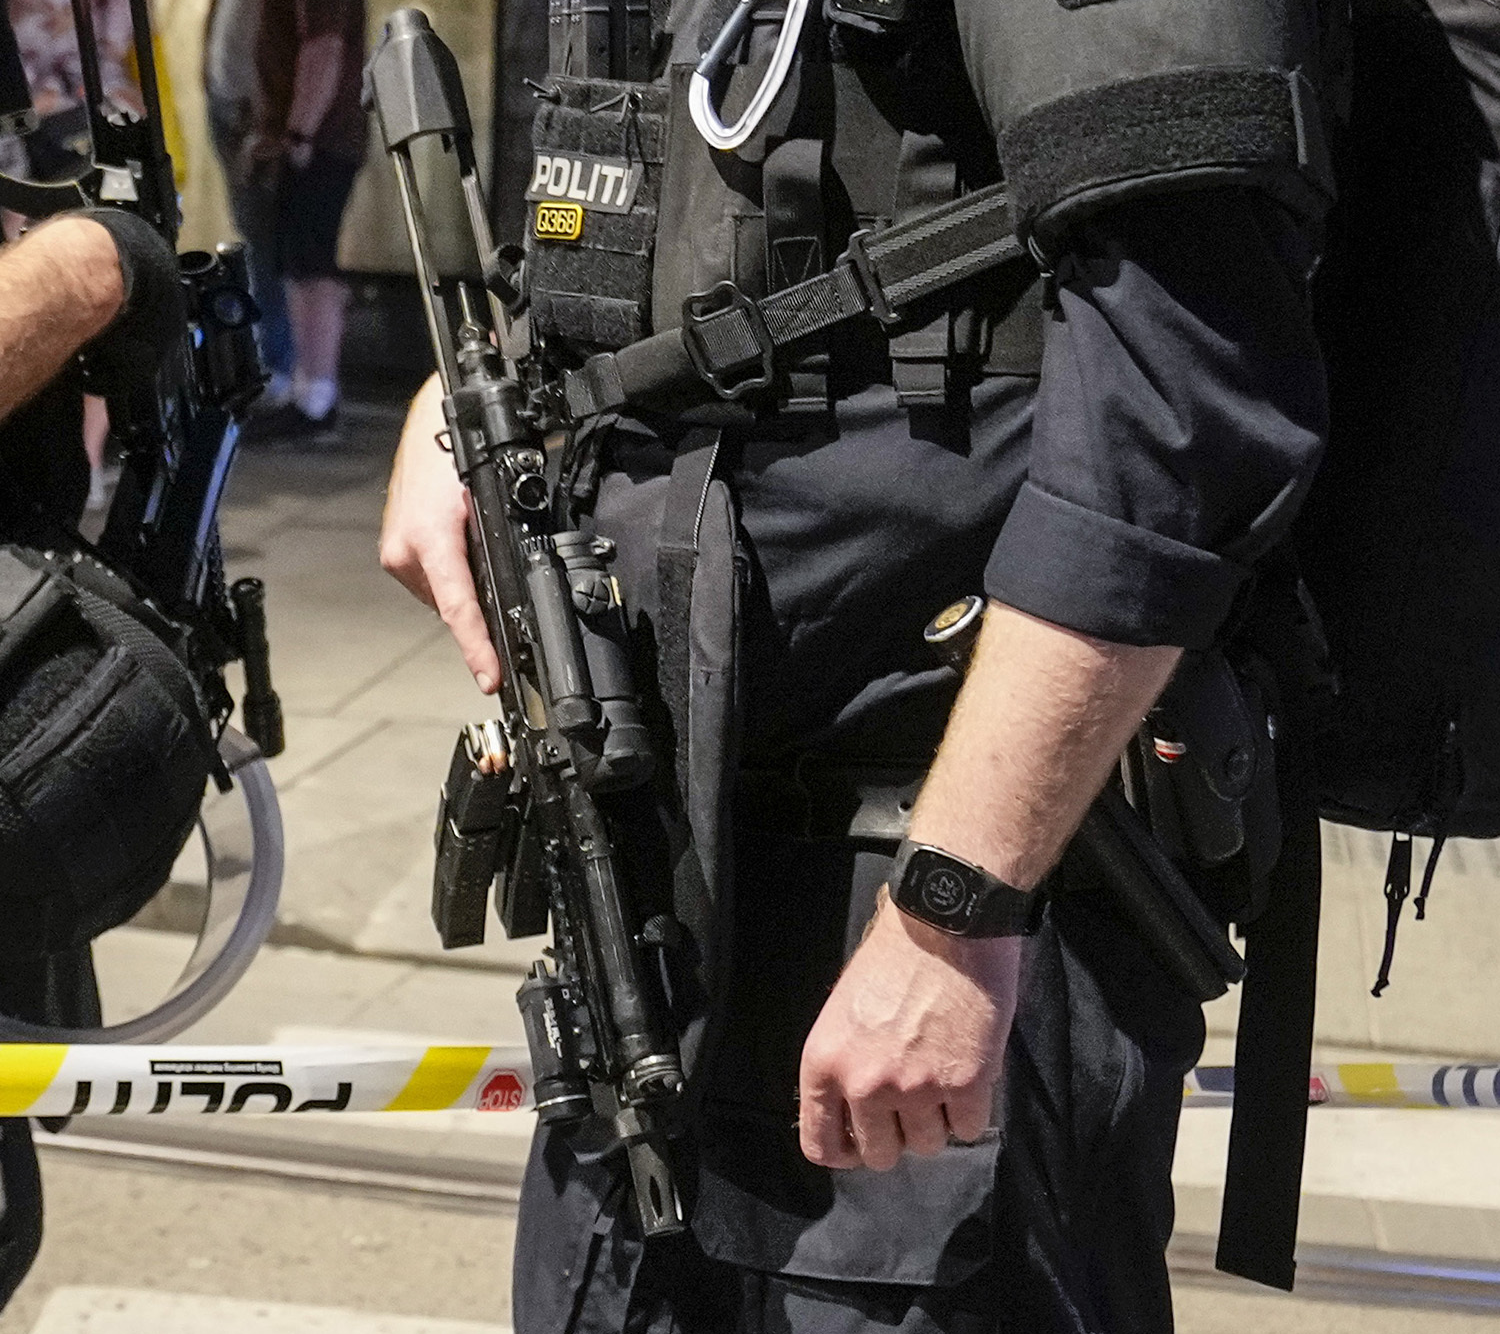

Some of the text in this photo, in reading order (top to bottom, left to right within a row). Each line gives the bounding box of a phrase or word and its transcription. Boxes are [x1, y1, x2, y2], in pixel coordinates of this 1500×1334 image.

[530, 154, 633, 207] POLITI
[536, 208, 577, 235] Q368
[479, 1089, 521, 1110] STOP
